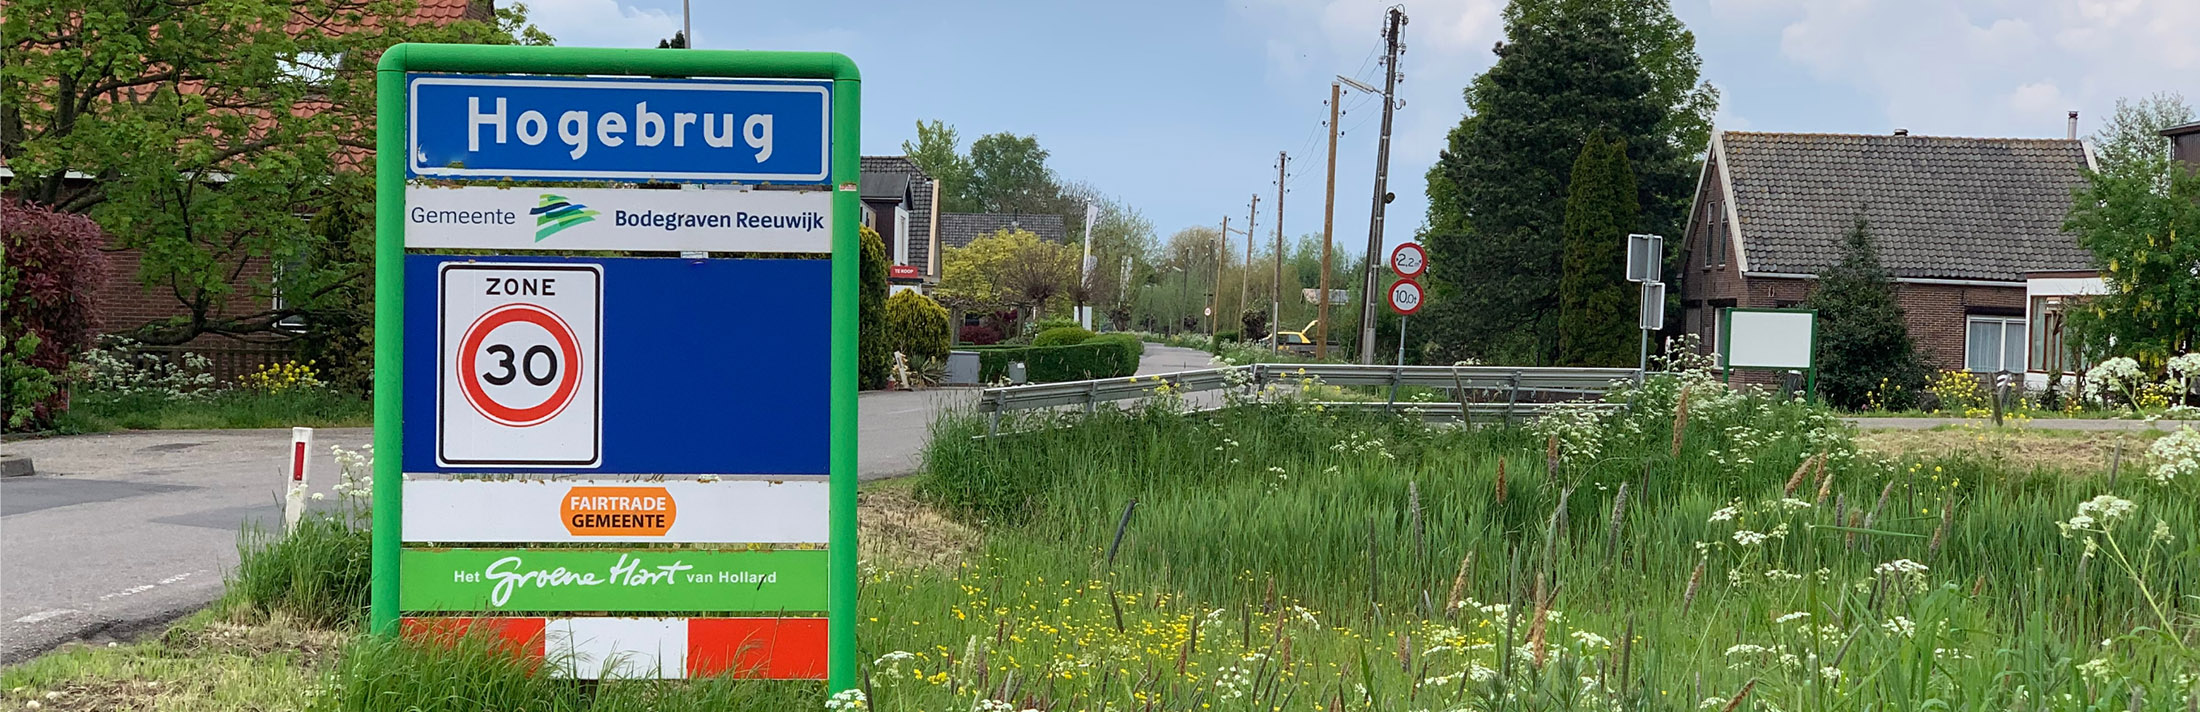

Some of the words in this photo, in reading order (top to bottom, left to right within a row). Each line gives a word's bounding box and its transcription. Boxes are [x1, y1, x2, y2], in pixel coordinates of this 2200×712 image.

[468, 97, 774, 164] Hogebrug
[411, 207, 516, 226] Gemeente
[615, 210, 731, 231] Bodegraven
[737, 211, 825, 232] Reeuwijk
[486, 278, 556, 296] ZONE
[482, 344, 558, 387] 30
[570, 496, 667, 511] FAIRTRADE
[572, 514, 666, 529] GEMEENTE
[454, 571, 480, 583] Het
[485, 556, 605, 607] Groene
[609, 553, 694, 586] Hart
[686, 575, 713, 583] van
[718, 571, 777, 583] Holland
